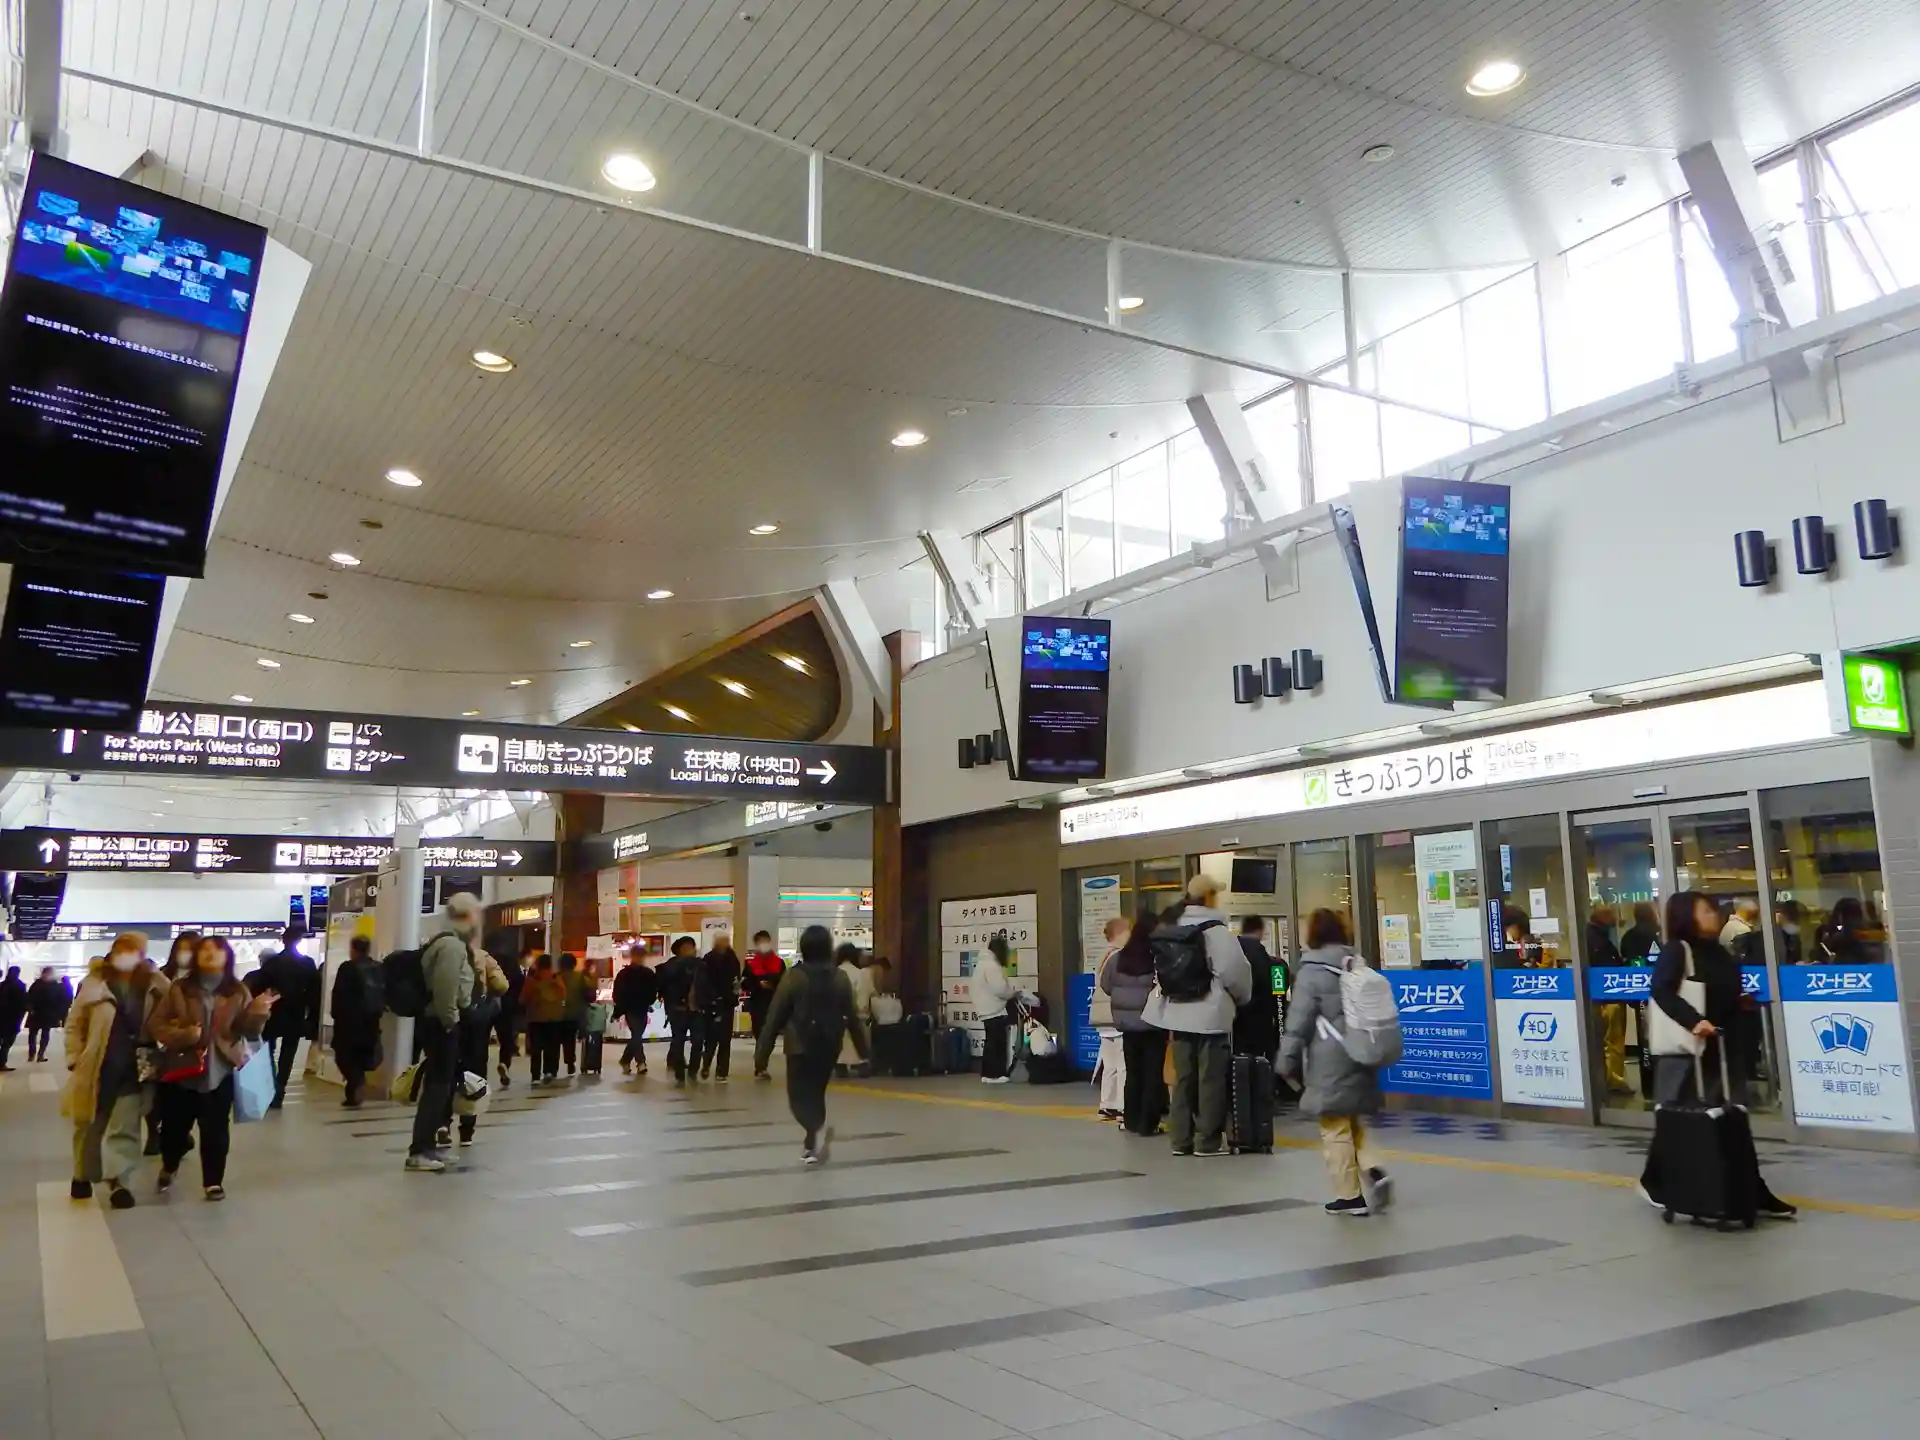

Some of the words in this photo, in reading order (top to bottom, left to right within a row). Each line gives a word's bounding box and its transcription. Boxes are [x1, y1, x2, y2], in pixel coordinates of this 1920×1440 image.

[139, 710, 314, 742] 動公園口(西口)
[356, 723, 383, 736] バス
[104, 735, 127, 749] For
[129, 736, 172, 752] Sports
[174, 739, 204, 752] Park
[206, 739, 244, 754] (West
[245, 742, 281, 757] Gate)
[503, 738, 654, 765] 自動きっぷうりば
[1485, 740, 1537, 759] Tickets
[355, 750, 405, 762] タクシー
[684, 748, 802, 775] 在来線(中央口)
[502, 760, 549, 775] Tickets
[1334, 746, 1475, 797] きっぷうりば
[671, 768, 702, 782] Local
[705, 770, 729, 783] Line
[738, 773, 774, 786] Central
[776, 776, 800, 787] Gate
[961, 904, 1017, 919] ダイヤ改正日
[1274, 968, 1283, 989] 入口
[1512, 975, 1558, 988] スマートEX
[1604, 973, 1652, 988] スマートEX
[1806, 973, 1873, 989] スマートEX
[1399, 985, 1466, 1005] スマートEX
[1528, 1020, 1547, 1034] ¥0
[1511, 1049, 1569, 1062] 今すぐ使えて
[1514, 1064, 1570, 1079] 年会費無料!
[1797, 1060, 1903, 1077] 交通系ICカードで
[1822, 1079, 1881, 1097] 乗車可能!
